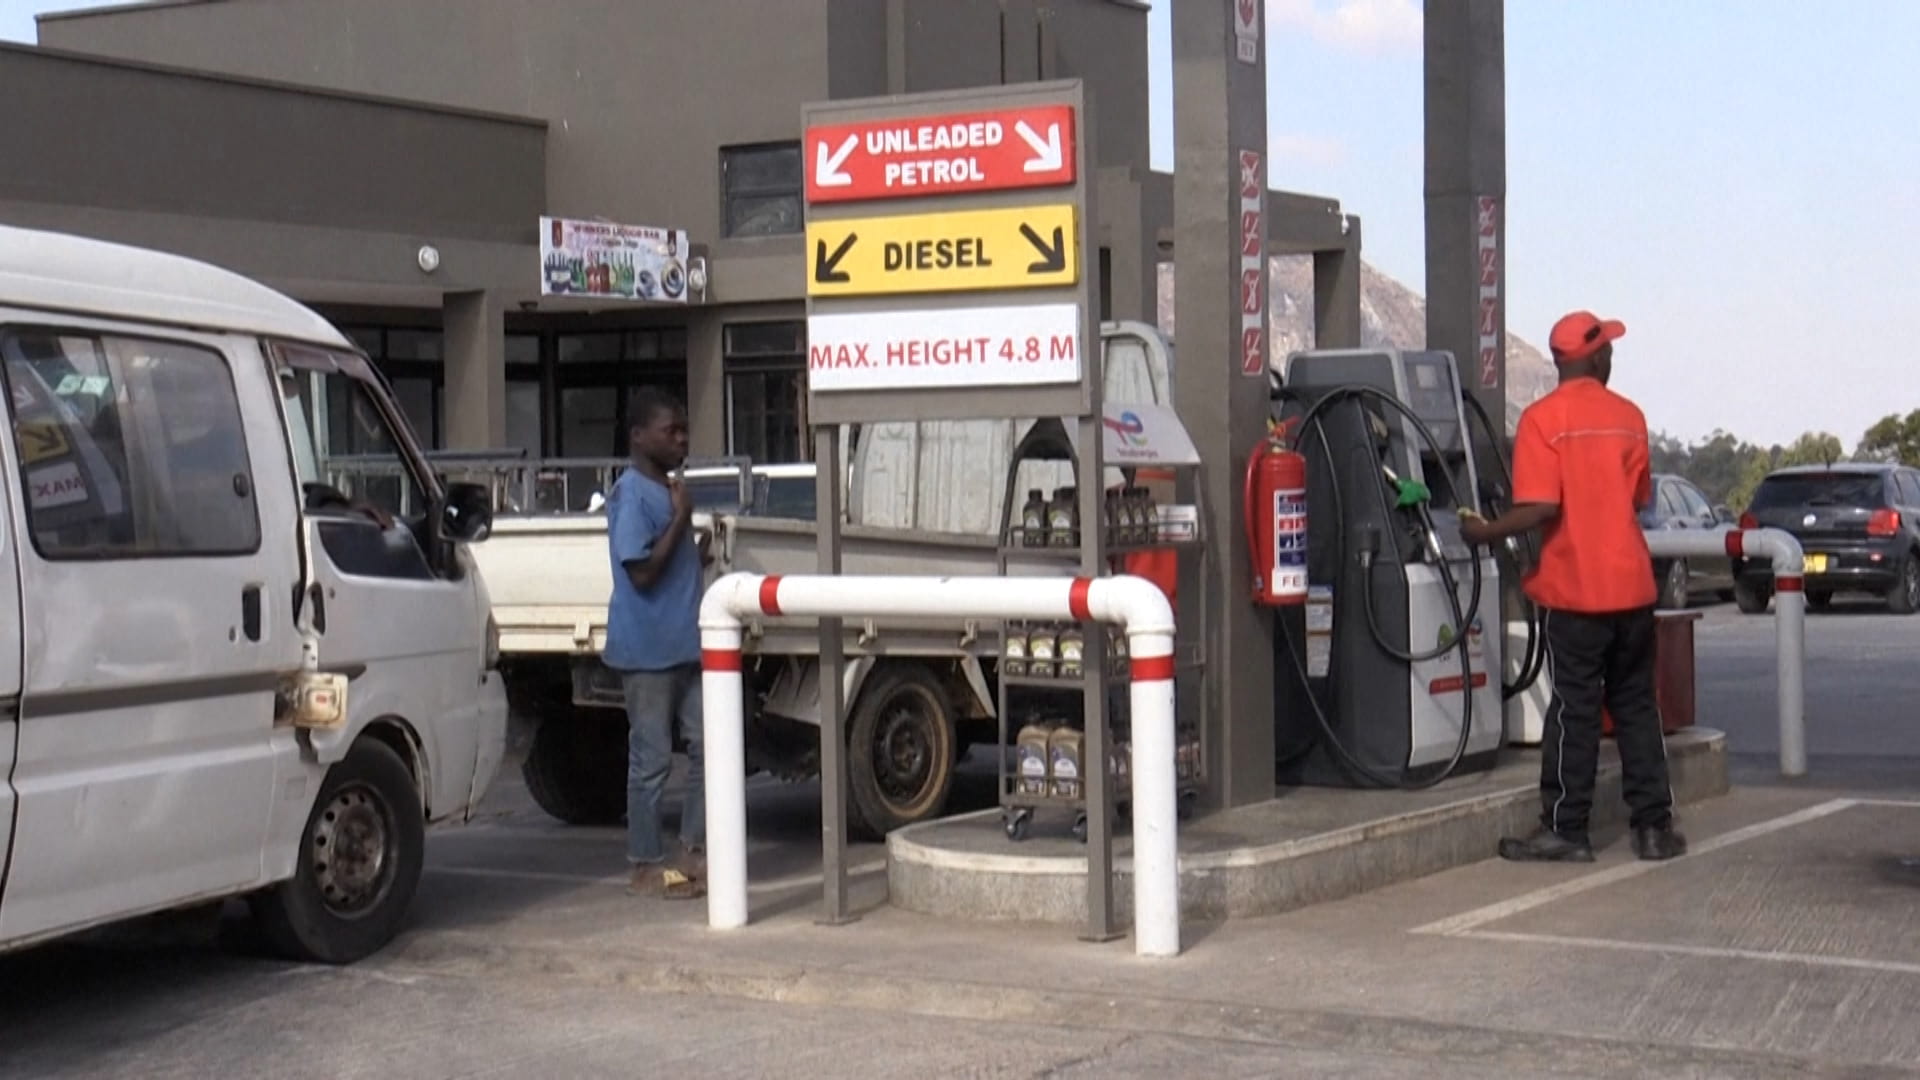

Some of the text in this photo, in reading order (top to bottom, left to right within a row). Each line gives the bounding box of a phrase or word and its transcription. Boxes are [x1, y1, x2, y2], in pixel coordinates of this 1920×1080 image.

[866, 121, 1003, 155] UNLEADED
[885, 157, 984, 187] PETROL
[884, 238, 992, 271] DIESEL
[810, 335, 1074, 369] MAX. HEIGHT 4.8 M
